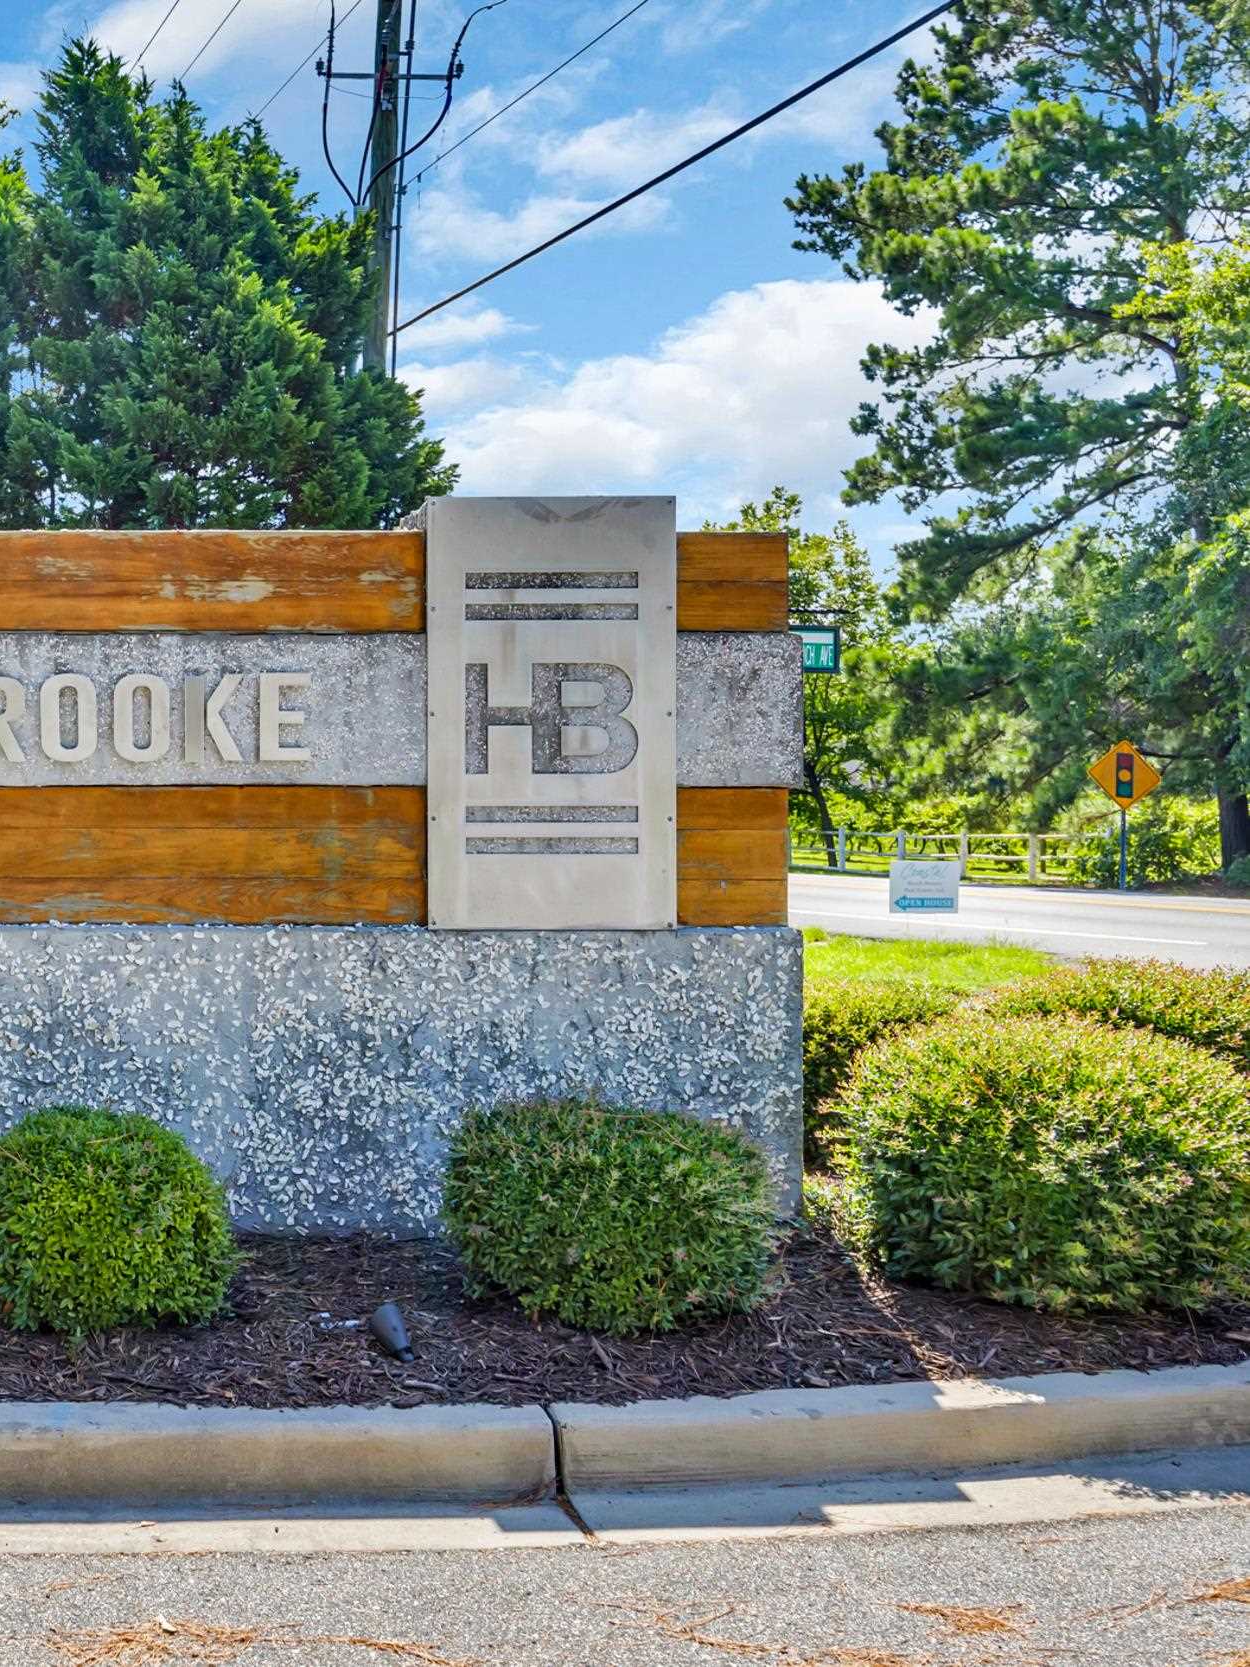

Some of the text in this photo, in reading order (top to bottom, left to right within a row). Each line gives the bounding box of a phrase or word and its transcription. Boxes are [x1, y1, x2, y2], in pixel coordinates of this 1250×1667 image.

[819, 644, 834, 666] AVE
[465, 663, 639, 775] HB
[898, 899, 951, 907] OPEN HOUSE
